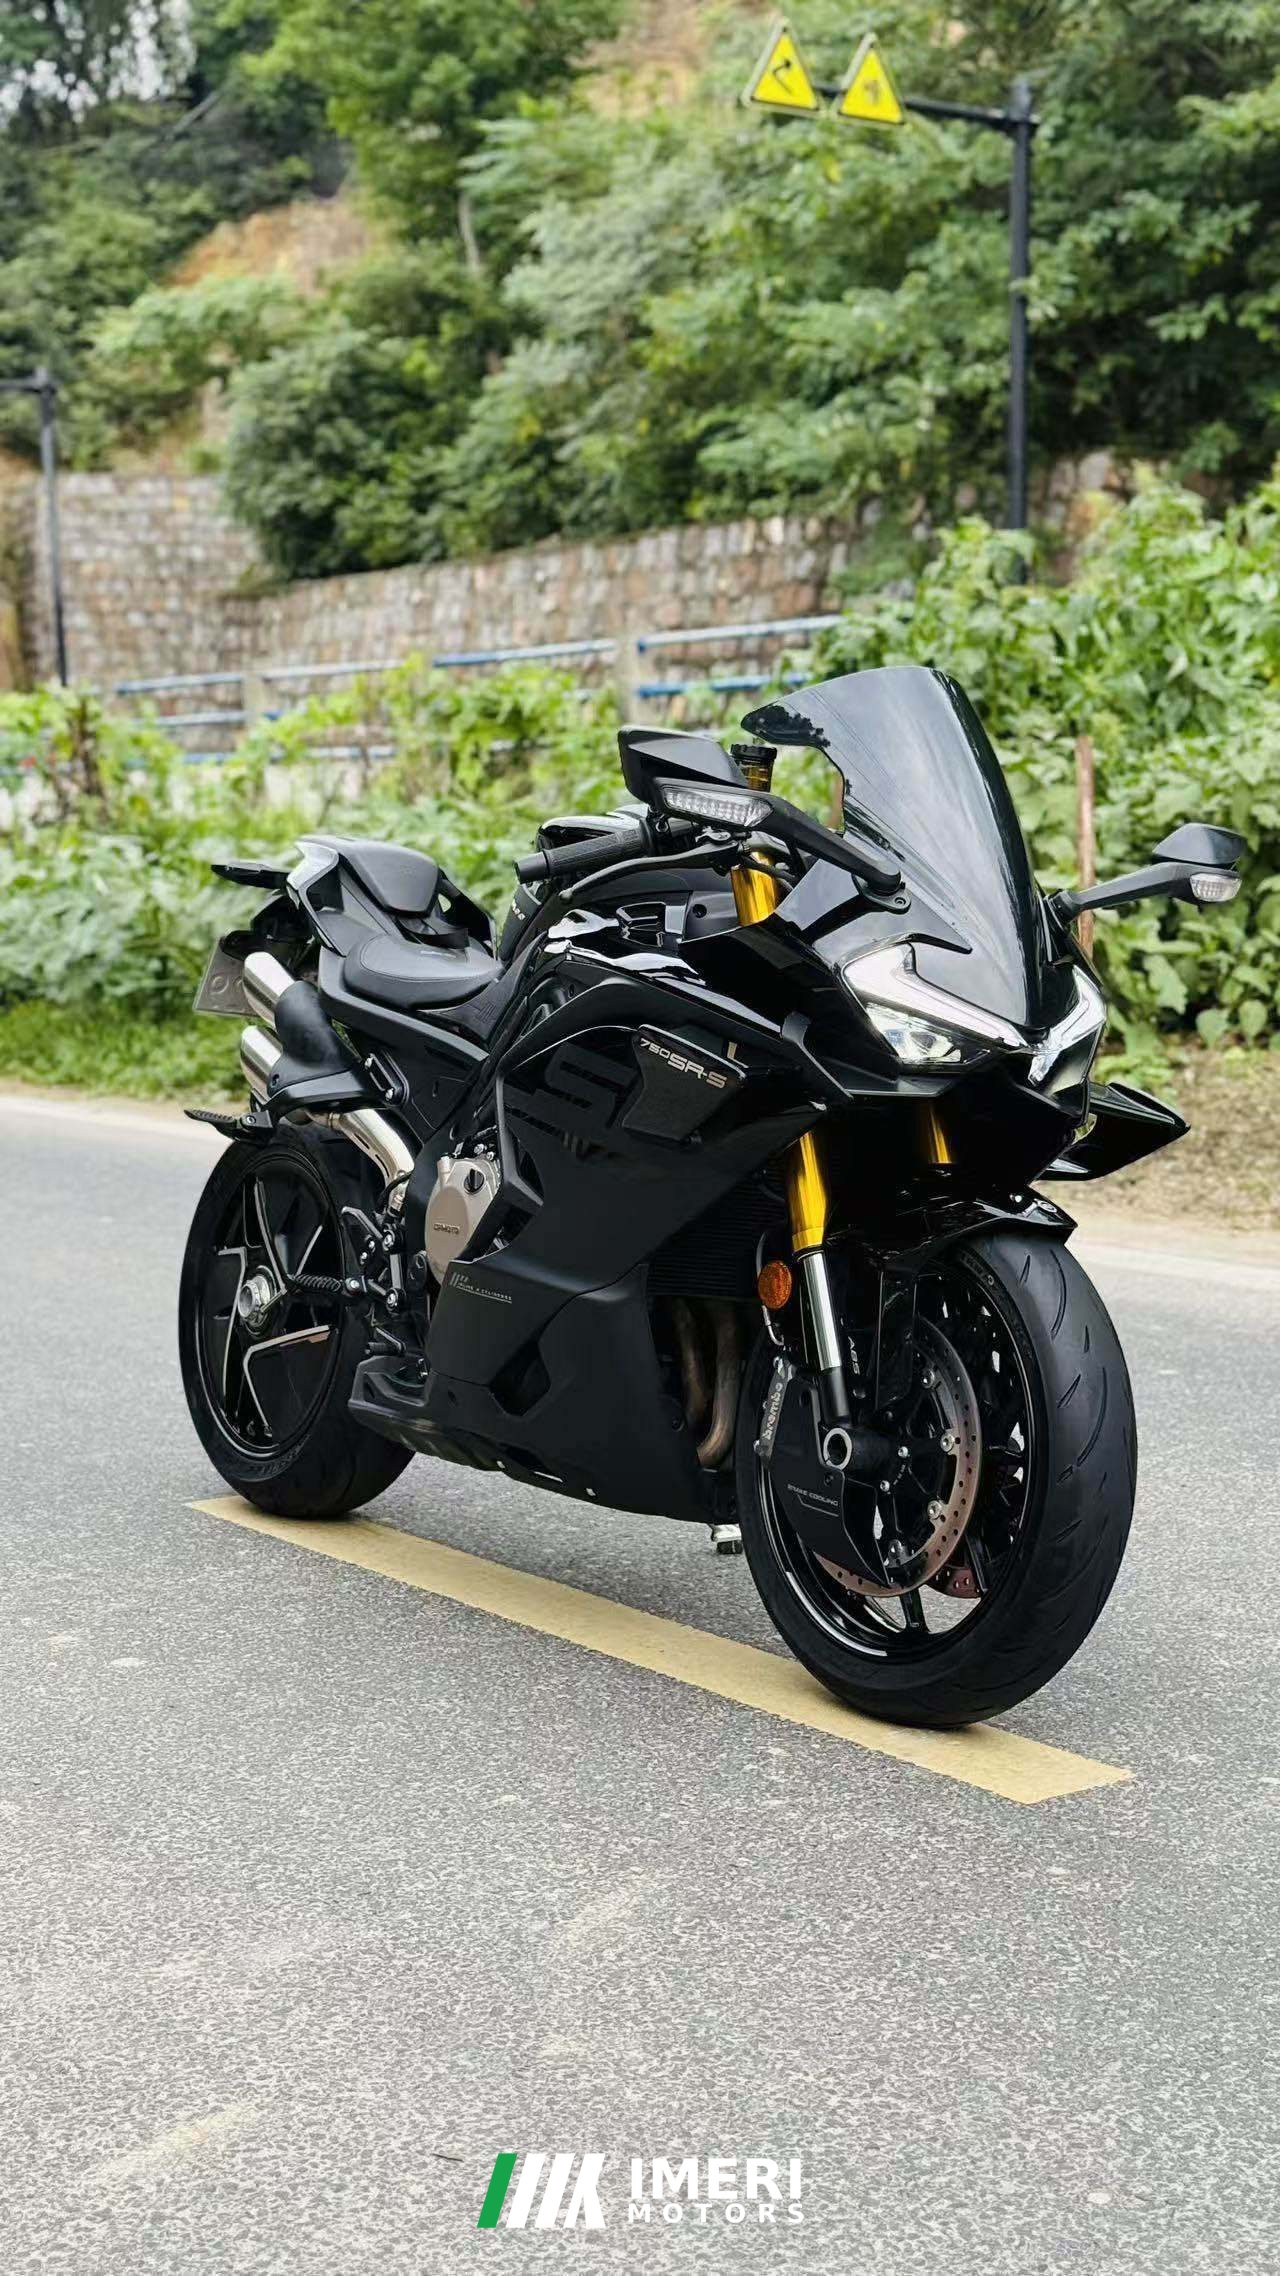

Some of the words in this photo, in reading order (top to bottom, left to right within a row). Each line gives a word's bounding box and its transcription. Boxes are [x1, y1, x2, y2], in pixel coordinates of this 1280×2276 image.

[640, 1037, 728, 1089] 750SR-S
[762, 1382, 783, 1441] brembo
[808, 1492, 839, 1507] COOLING
